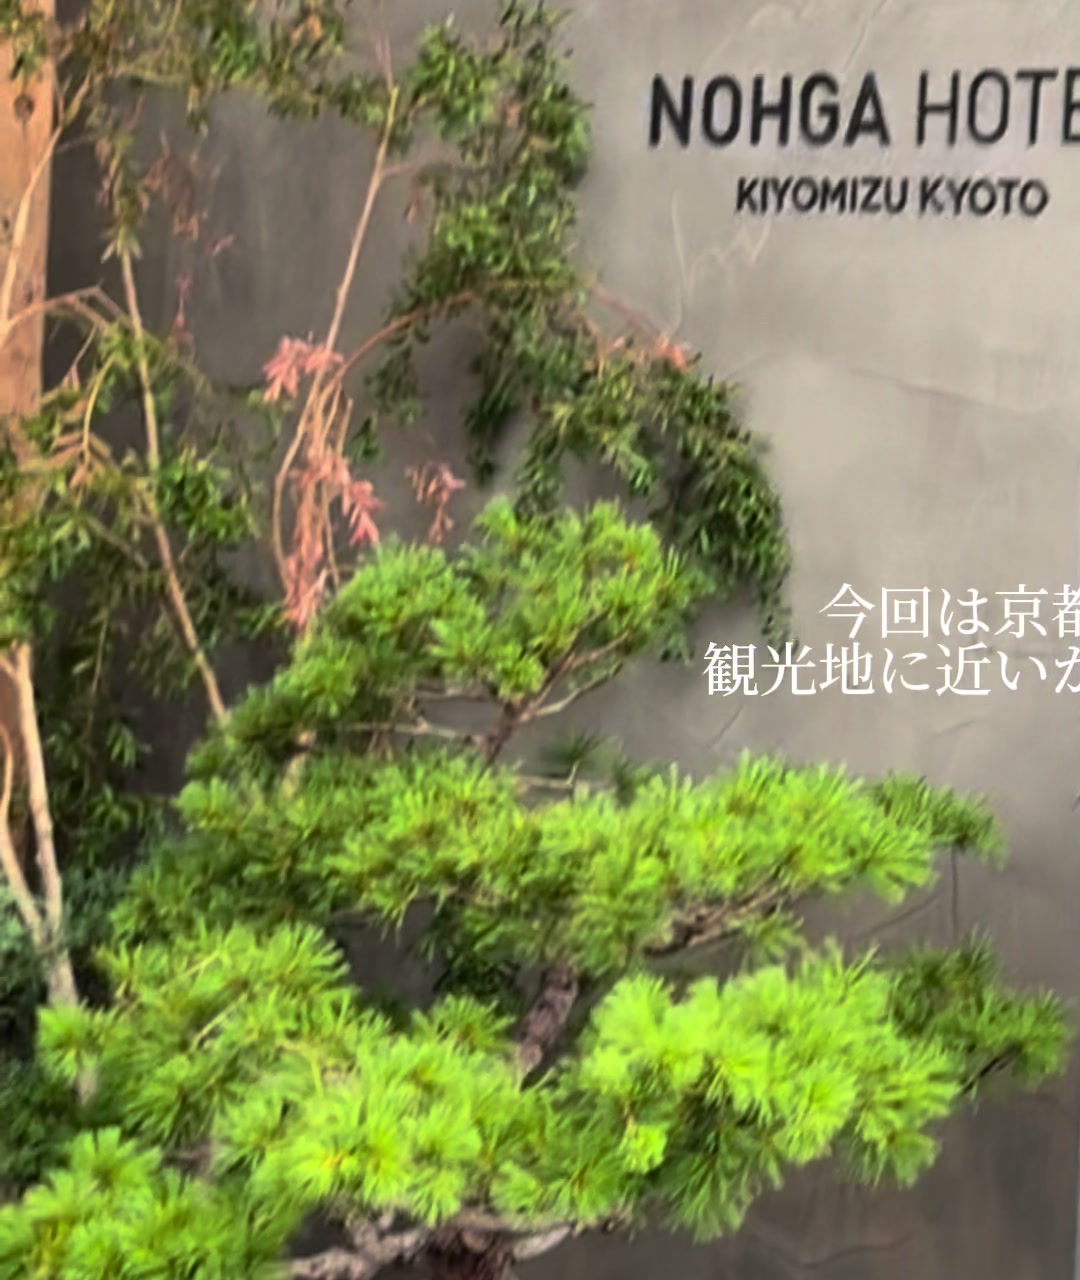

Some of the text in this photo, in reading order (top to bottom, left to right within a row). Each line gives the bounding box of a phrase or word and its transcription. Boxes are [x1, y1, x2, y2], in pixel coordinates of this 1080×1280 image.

[649, 72, 891, 148] NOHGA
[735, 176, 1050, 217] KIYOMIZU KYOTO
